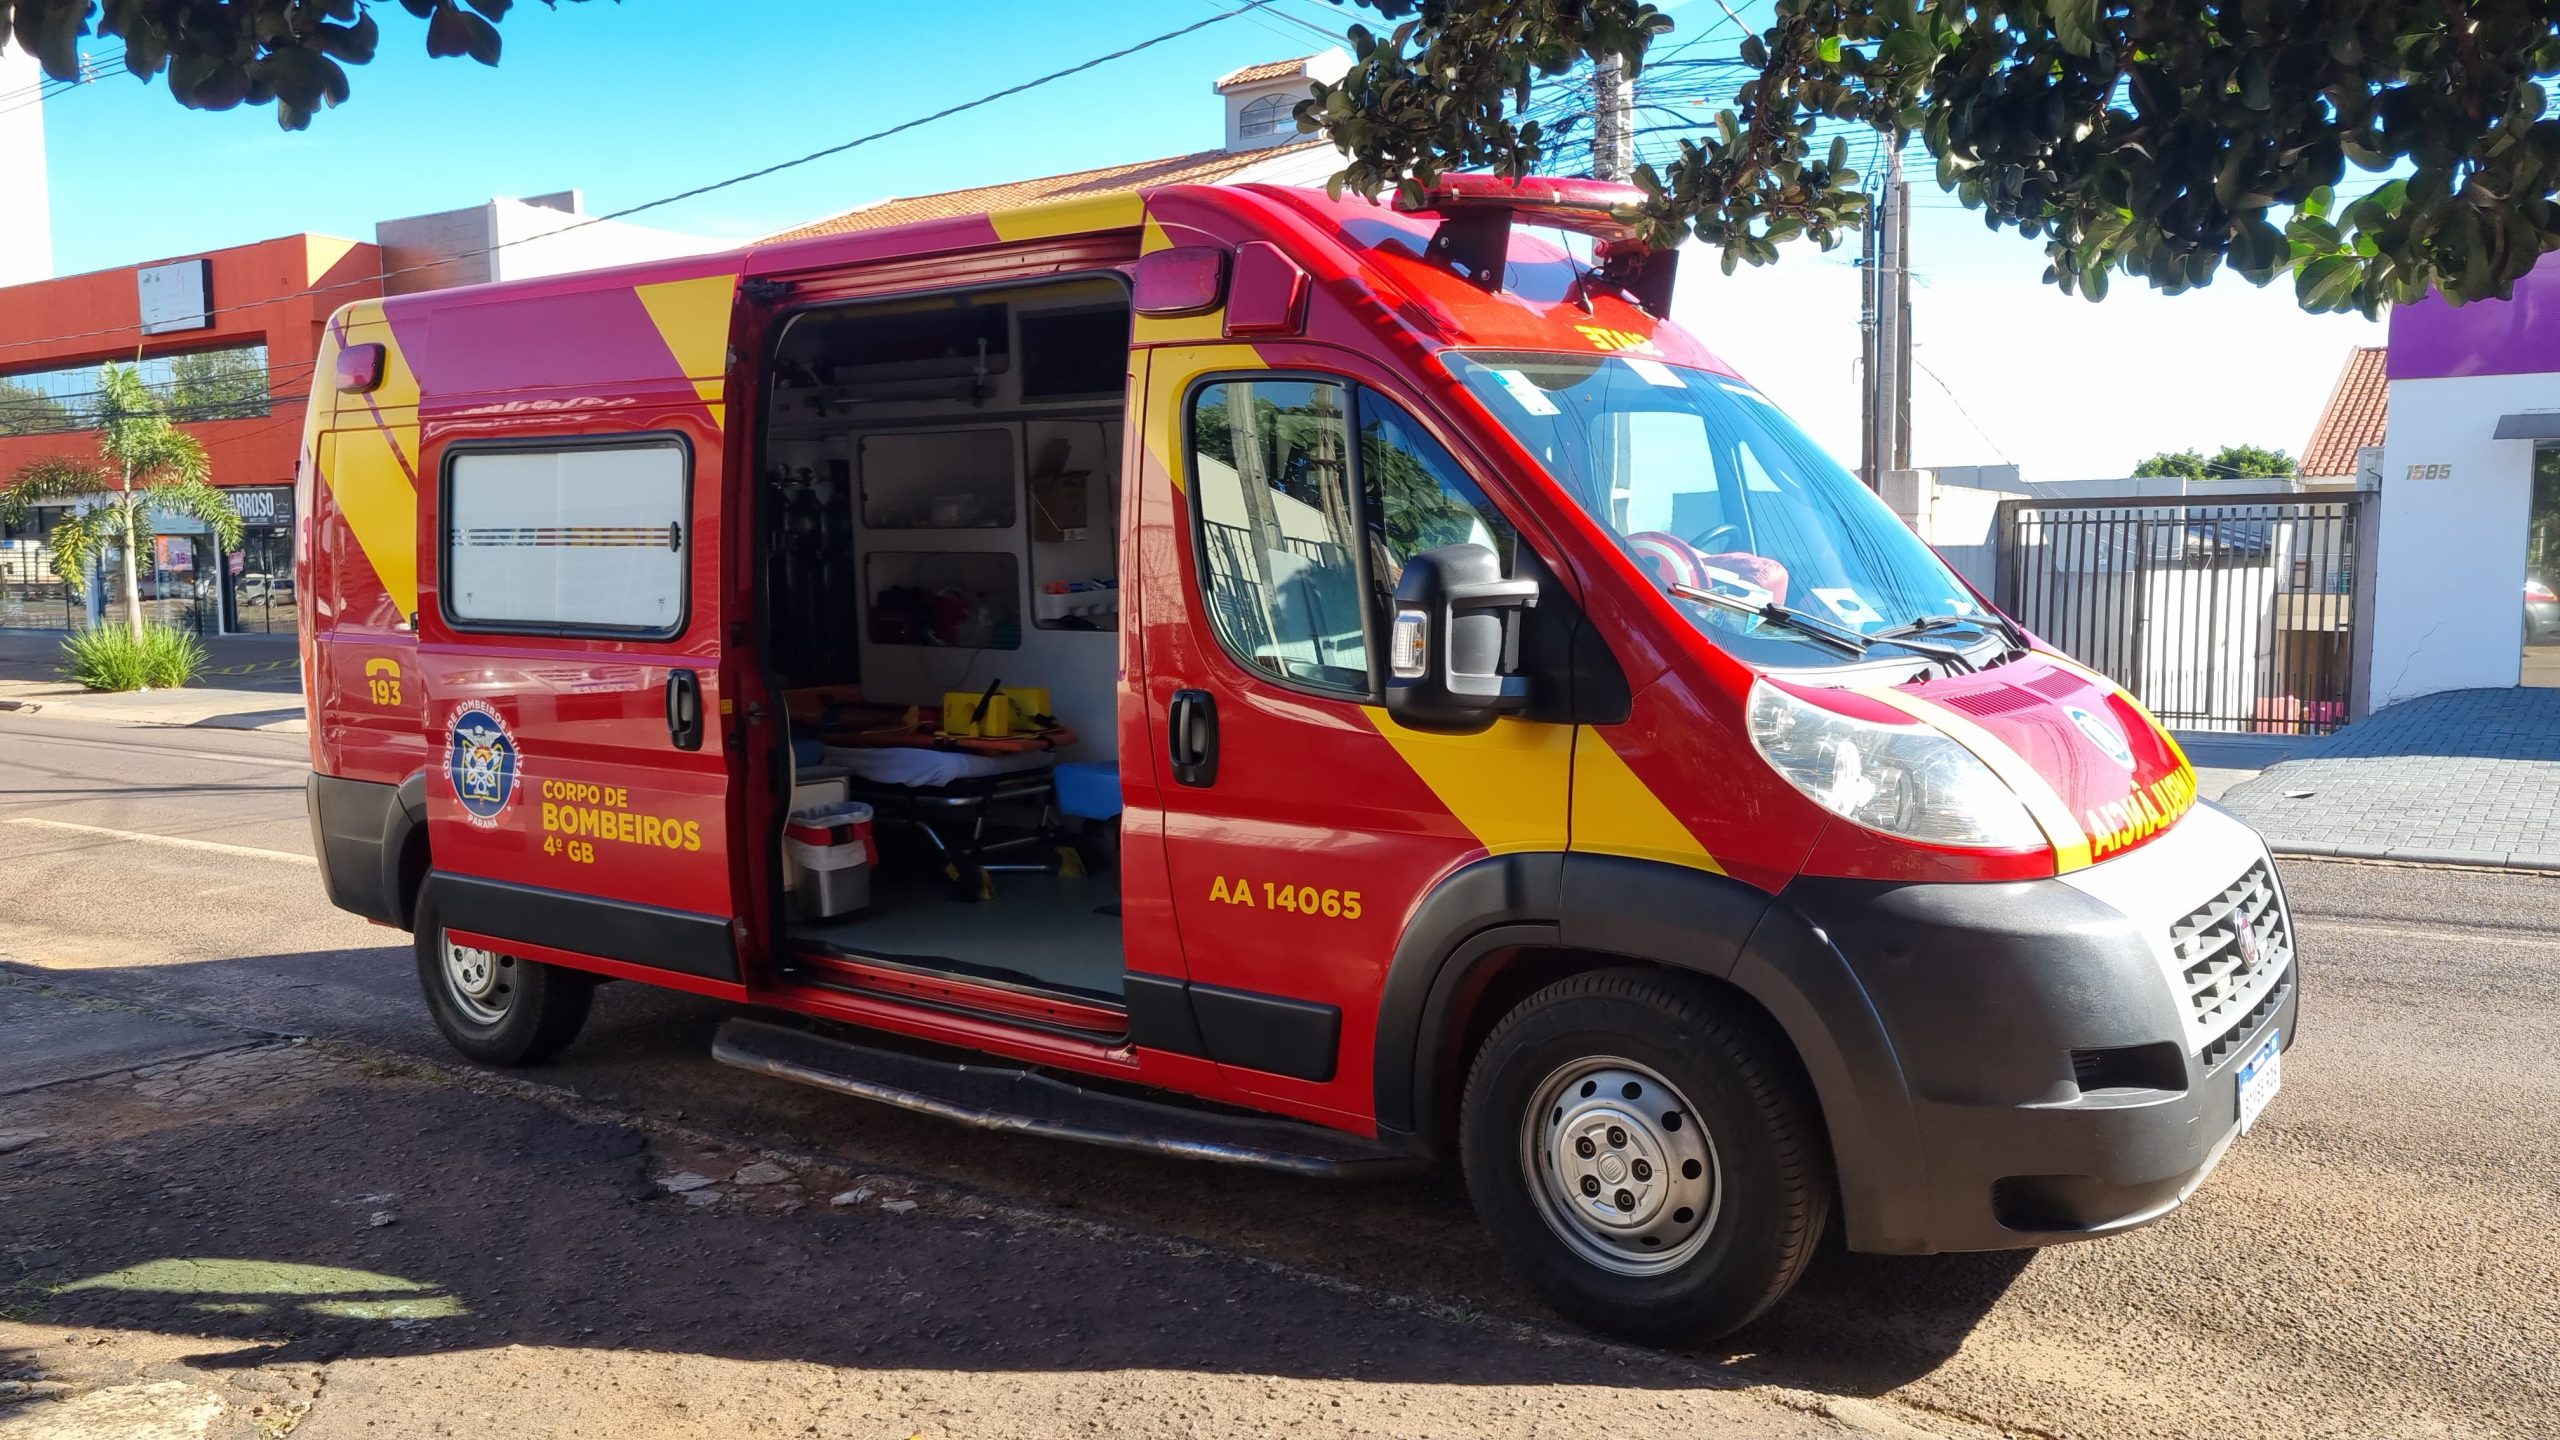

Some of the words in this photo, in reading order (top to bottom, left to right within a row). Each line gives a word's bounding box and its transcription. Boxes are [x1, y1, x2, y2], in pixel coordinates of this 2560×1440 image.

[2406, 464, 2452, 480] 1585
[368, 679, 402, 706] 193
[447, 713, 458, 730] DE
[456, 699, 508, 730] BOMBEIROS
[443, 732, 454, 780] CORPO
[506, 730, 524, 789] MILITAR
[542, 780, 601, 805] CORPO
[604, 786, 628, 808] DE
[542, 802, 701, 852] BOMBEIROS
[567, 840, 595, 864] GB
[1208, 875, 1256, 907] AA
[1263, 882, 1362, 920] 14065
